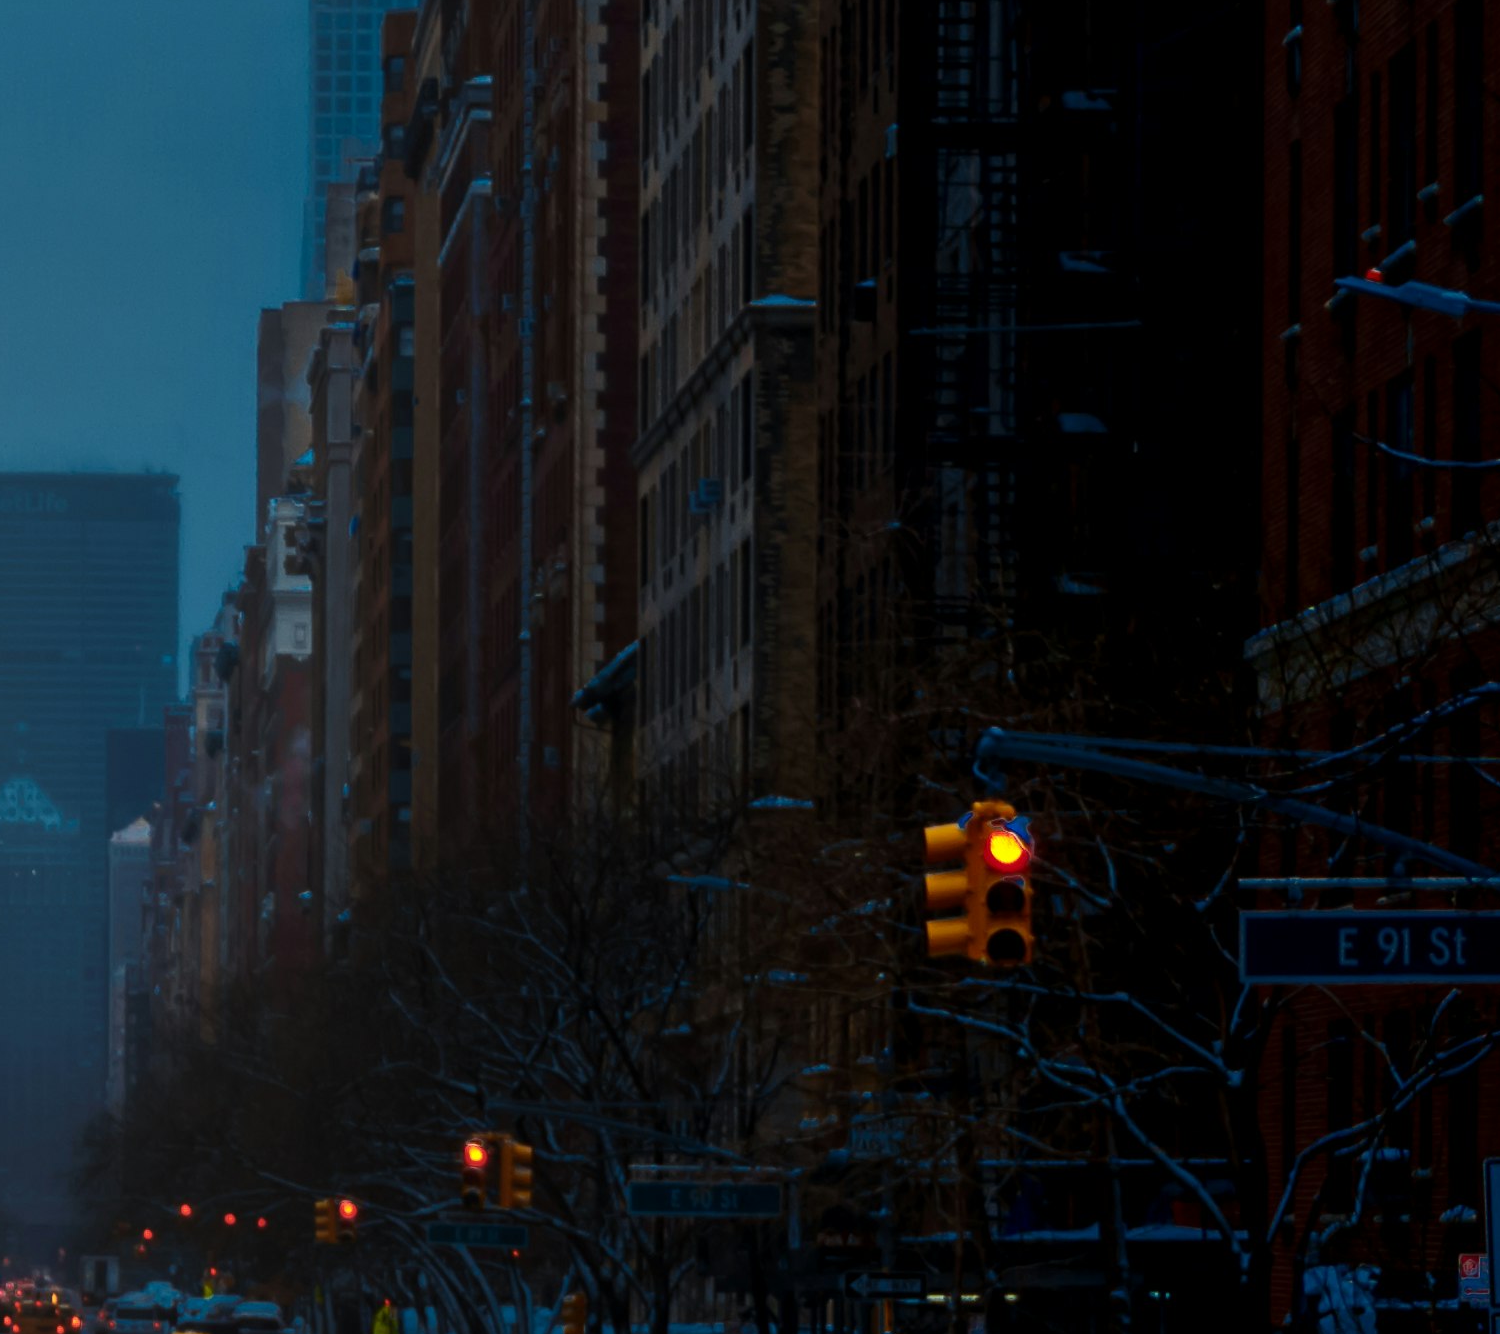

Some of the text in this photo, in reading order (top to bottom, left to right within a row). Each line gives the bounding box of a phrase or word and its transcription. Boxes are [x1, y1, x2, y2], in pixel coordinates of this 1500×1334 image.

[1337, 926, 1466, 967] E 91 St
